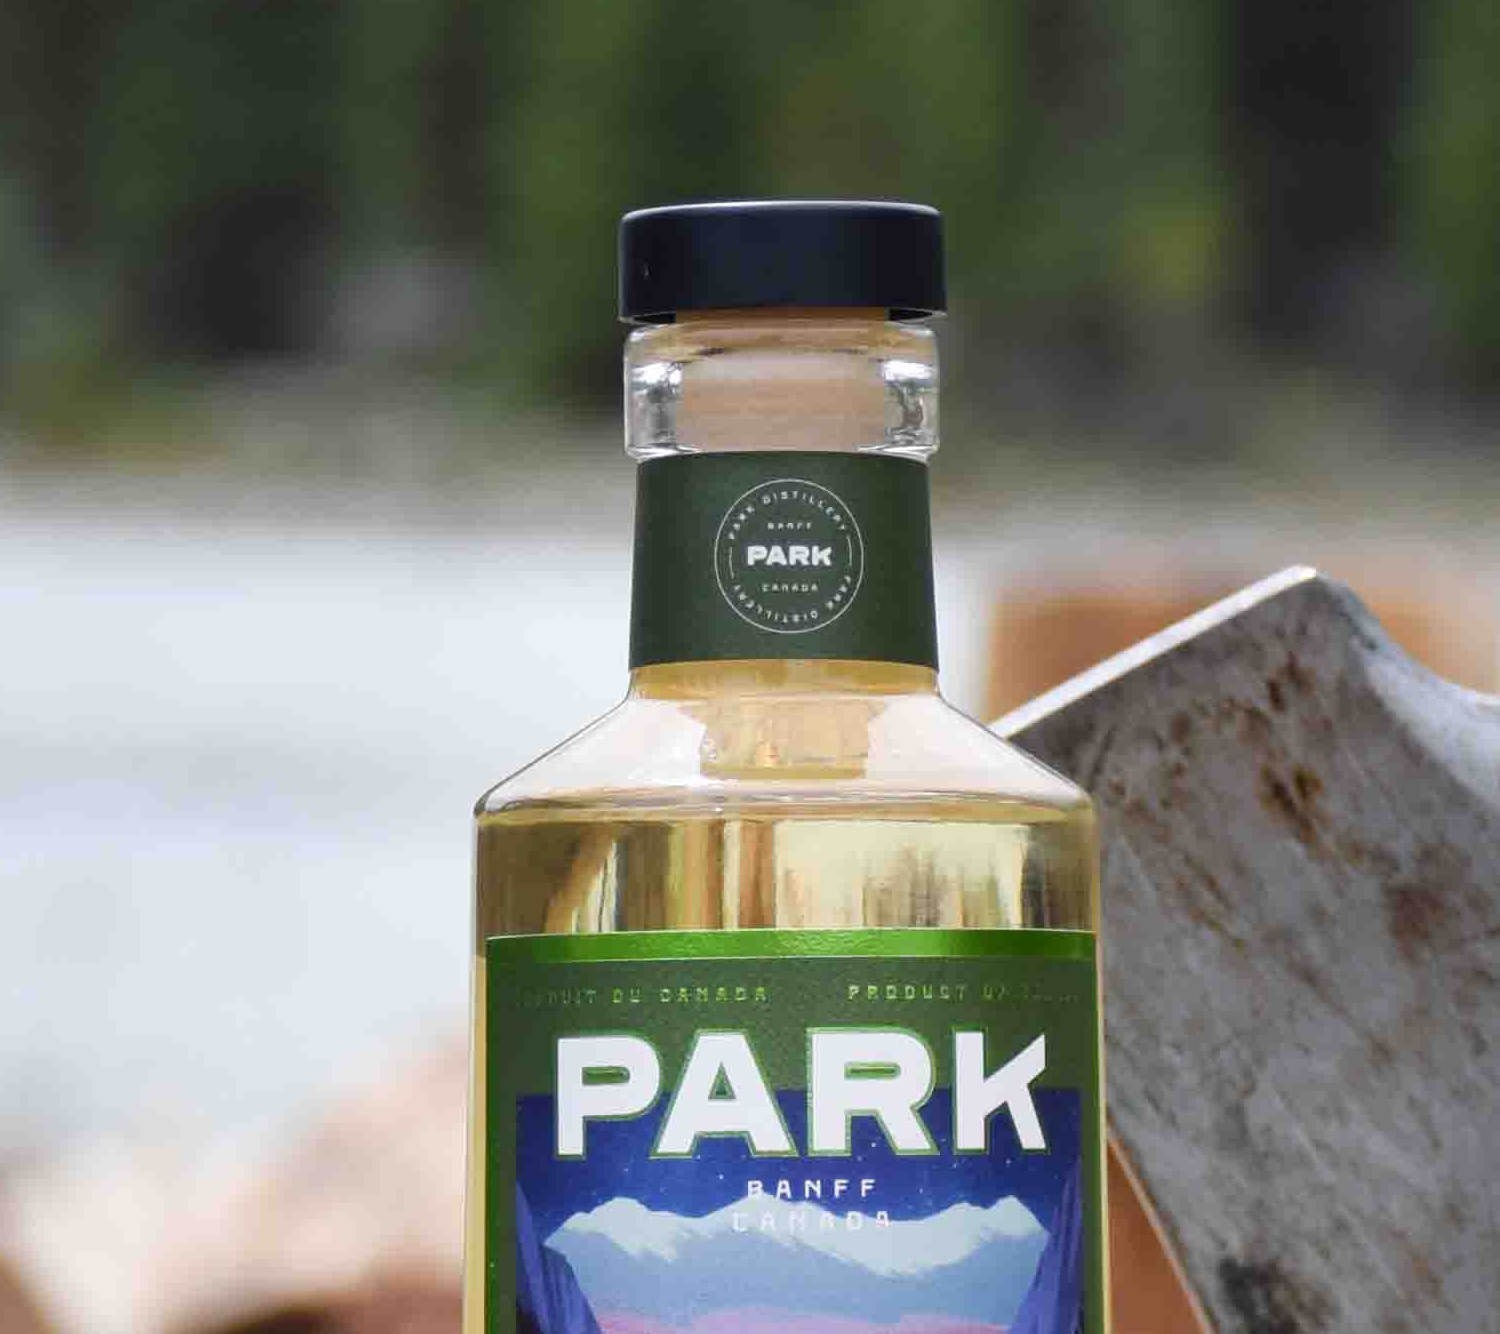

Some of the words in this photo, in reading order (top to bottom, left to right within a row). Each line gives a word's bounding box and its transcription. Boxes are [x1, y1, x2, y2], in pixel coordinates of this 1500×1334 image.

[747, 545, 833, 566] PARK
[762, 583, 818, 593] CANADA
[659, 985, 769, 1004] CANADA
[848, 984, 965, 1001] PRODUCT
[556, 1027, 1048, 1157] PARK
[747, 1178, 876, 1199] BANFF
[732, 1210, 891, 1235] CANADA
